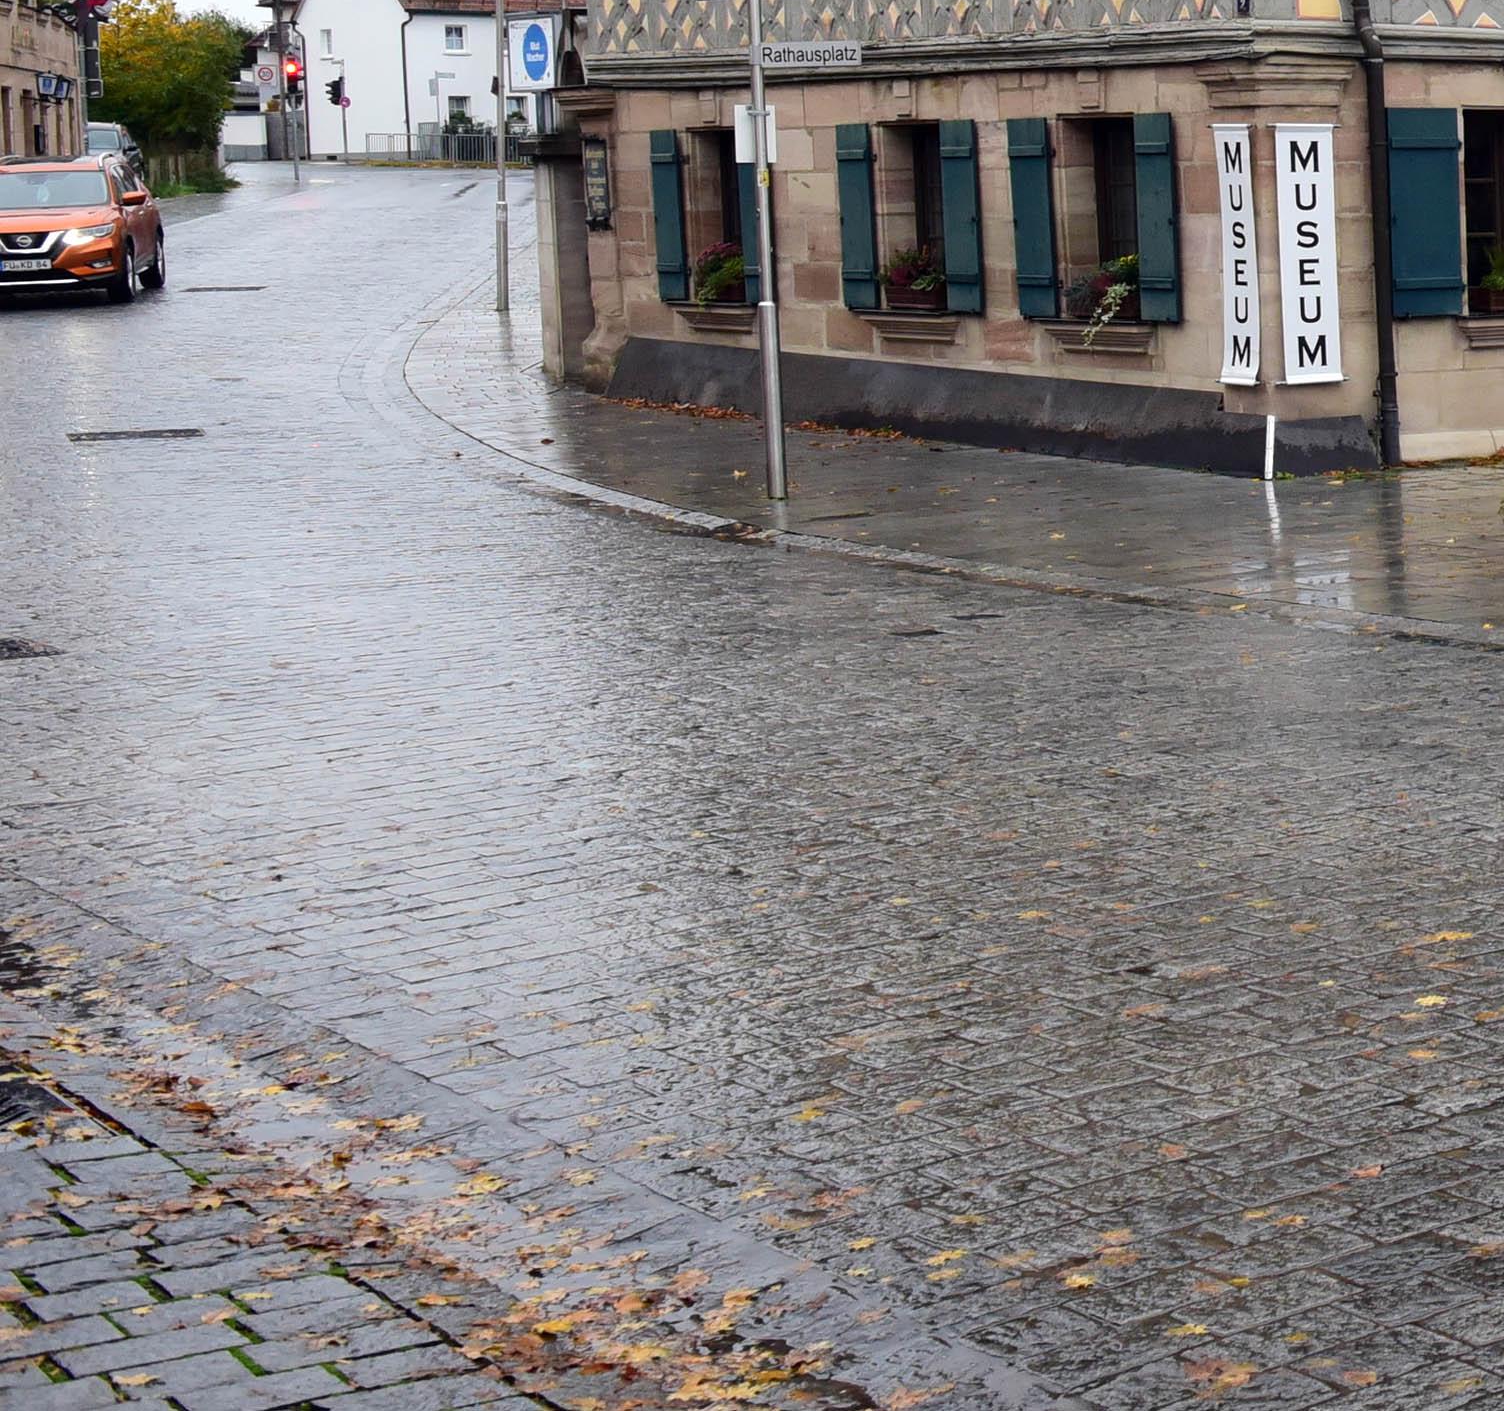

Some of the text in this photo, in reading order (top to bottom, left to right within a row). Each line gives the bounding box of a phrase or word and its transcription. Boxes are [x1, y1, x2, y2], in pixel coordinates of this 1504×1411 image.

[762, 46, 857, 65] Rathausplatz
[1224, 141, 1251, 368] MUSEUM
[1290, 140, 1327, 368] MUSEUM
